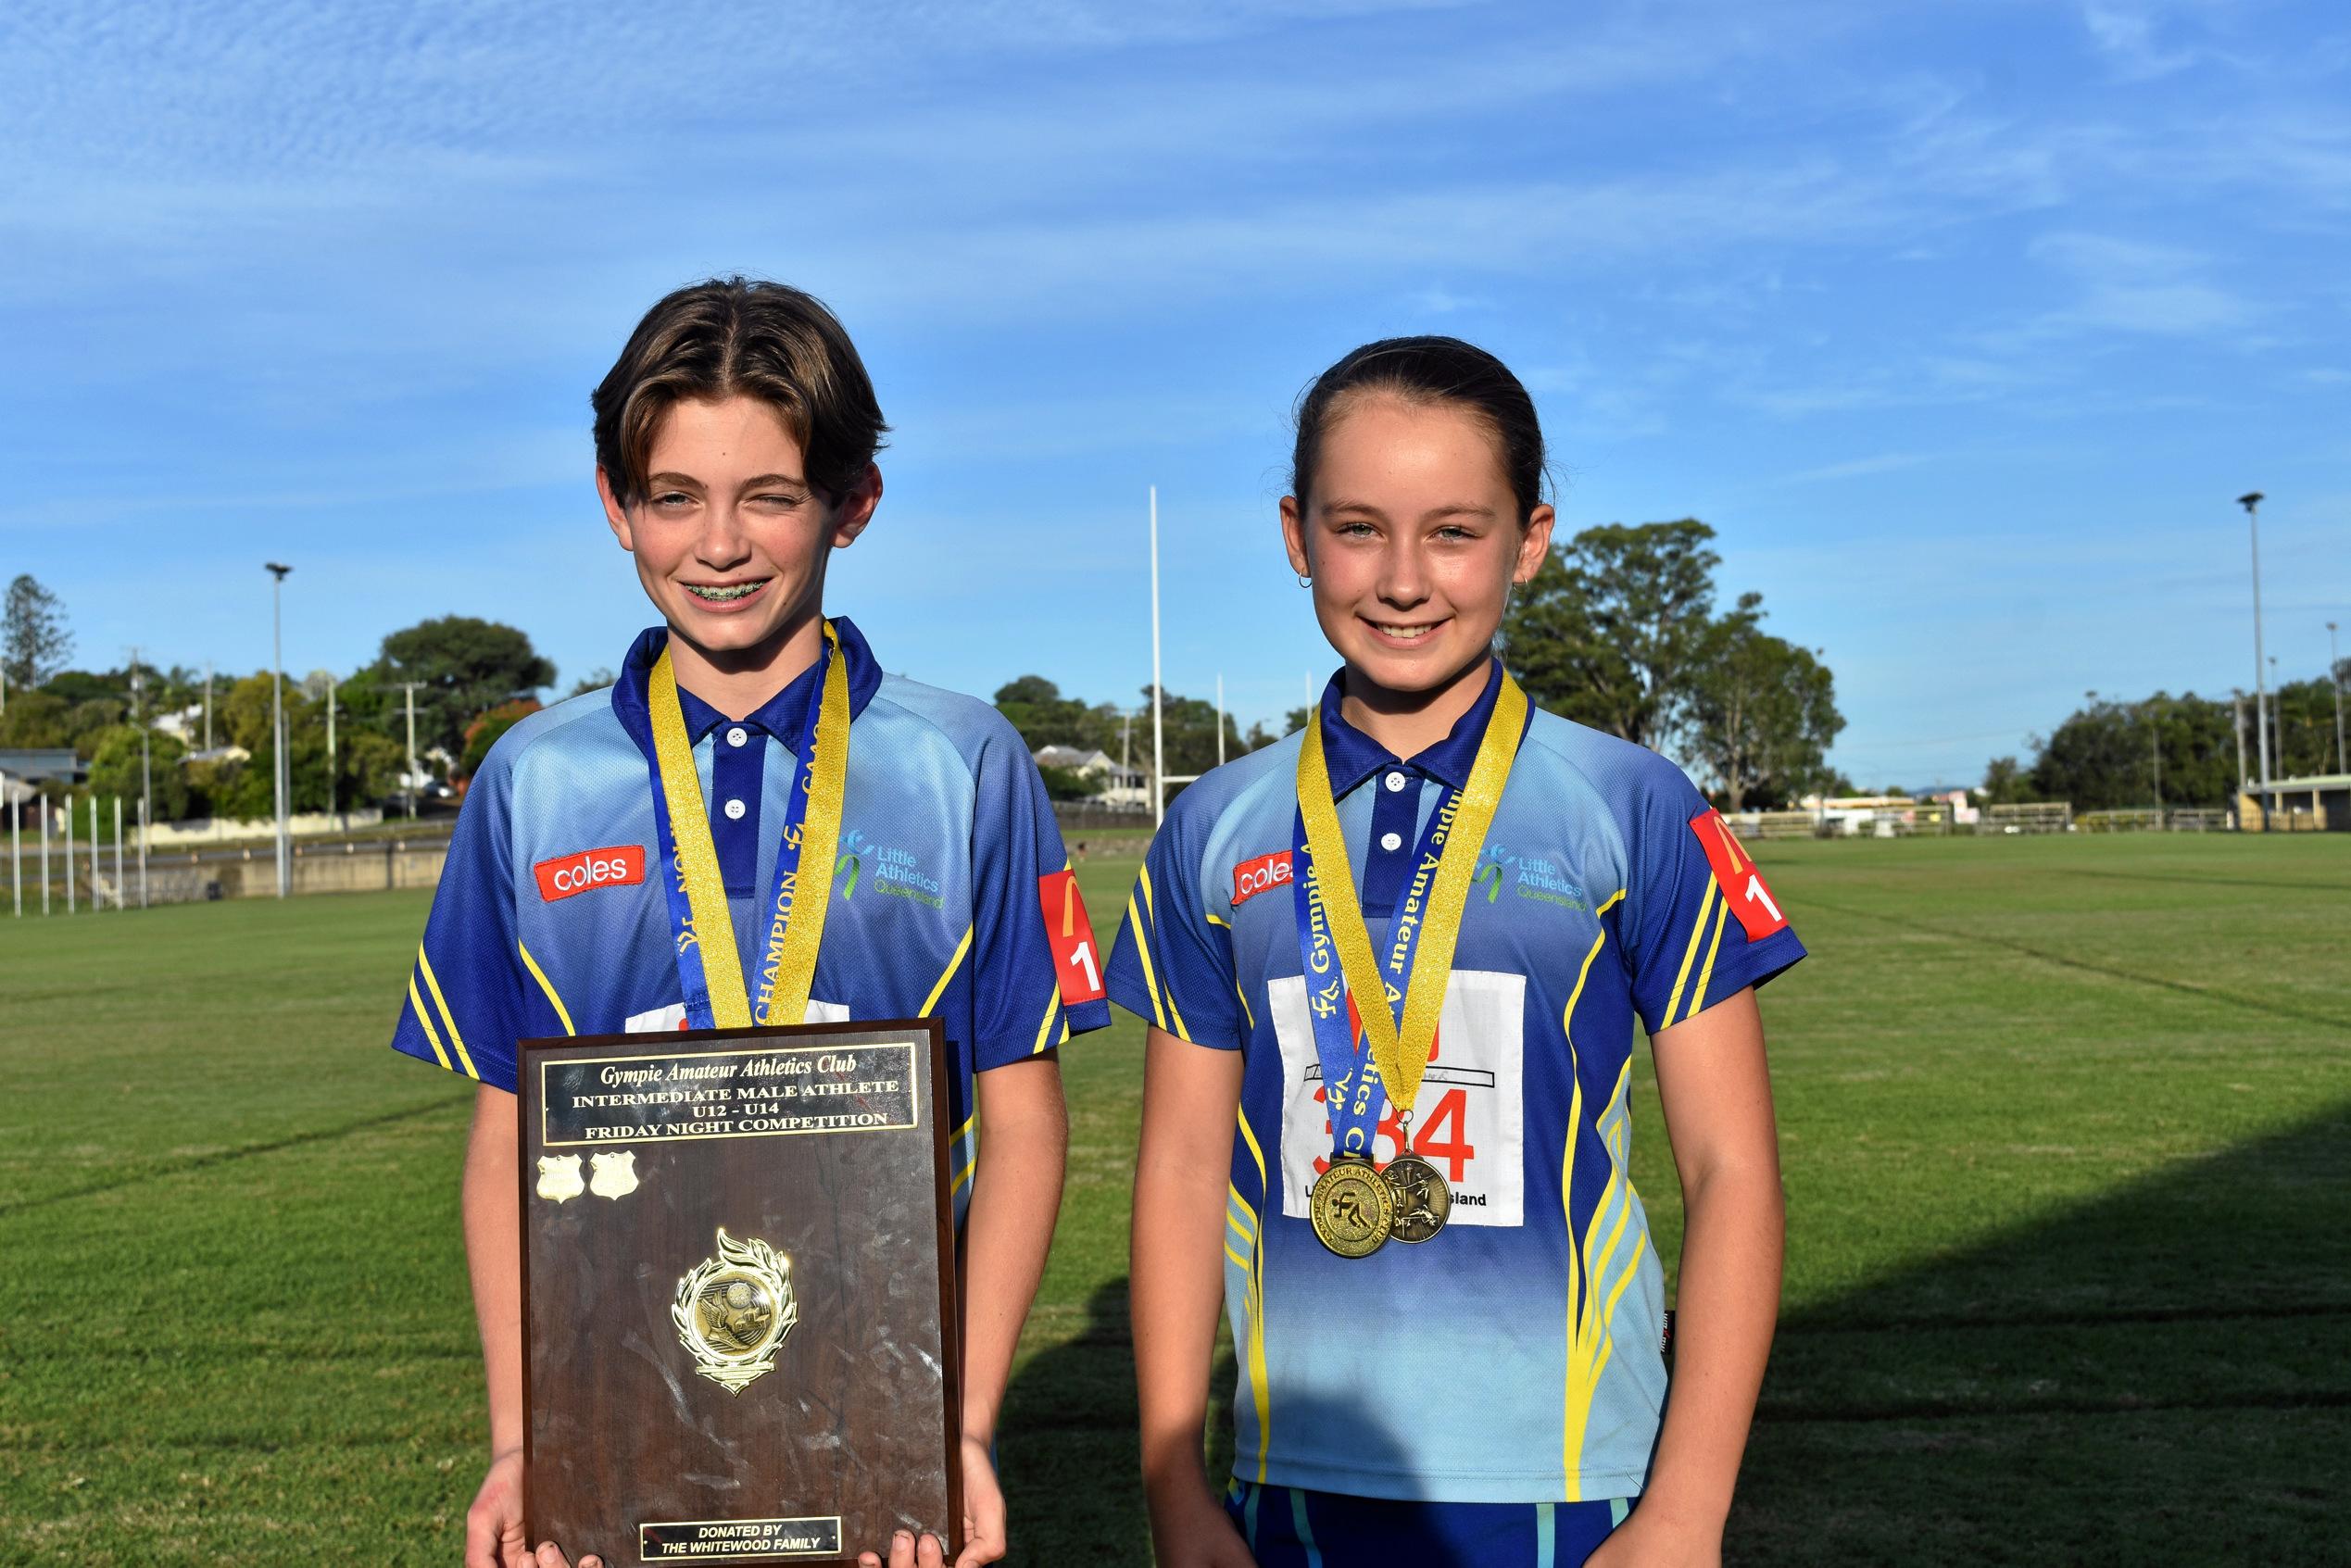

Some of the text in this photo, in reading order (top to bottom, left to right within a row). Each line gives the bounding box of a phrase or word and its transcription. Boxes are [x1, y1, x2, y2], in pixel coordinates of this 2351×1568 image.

[878, 846, 916, 868] Little
[1519, 857, 1556, 875] Little
[554, 856, 627, 891] coles
[875, 862, 938, 892] Athletics
[1239, 859, 1293, 895] cole
[1517, 872, 1581, 897] Athletics
[1389, 851, 1440, 974] Amateur
[1745, 874, 1782, 922] 1
[1070, 941, 1100, 992] 1
[601, 1054, 857, 1088] Gympie Amateur Athletics Club
[572, 1080, 899, 1109] INTERMEDIATE MALE ATHLETE
[693, 1104, 727, 1118] U12
[744, 1102, 780, 1115] U14
[585, 1112, 888, 1140] FRIDAY NIGHT COMPETITION
[1315, 1167, 1352, 1201] AMATEUR
[1449, 1191, 1486, 1206] sland
[698, 1524, 783, 1538] DONATED BY
[661, 1537, 821, 1555] THE WHITEWOOD FAMILY
